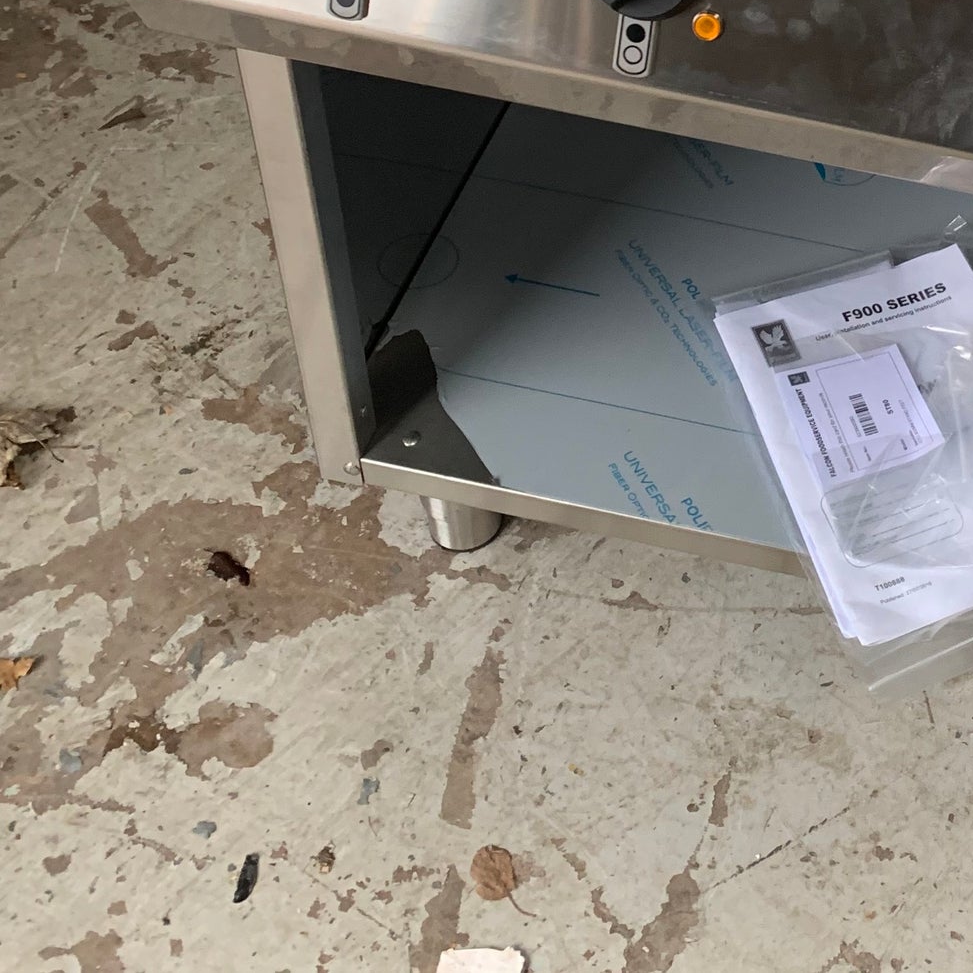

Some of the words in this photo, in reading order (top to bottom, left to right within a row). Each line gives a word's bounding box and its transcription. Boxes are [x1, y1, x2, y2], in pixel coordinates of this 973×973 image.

[628, 239, 682, 308] UNIVERSAL
[842, 303, 883, 322] F900
[886, 282, 947, 310] SERIES
[871, 318, 884, 326] and
[885, 309, 915, 323] servicing
[914, 295, 952, 312] instructions
[669, 323, 718, 387] TECHNOLOGIES
[795, 388, 813, 418] EQUIPMENT
[808, 418, 829, 455] FOODSERVICE
[608, 462, 631, 492] FIBER
[823, 455, 837, 477] FALCON
[623, 450, 677, 523] UNIVERSA
